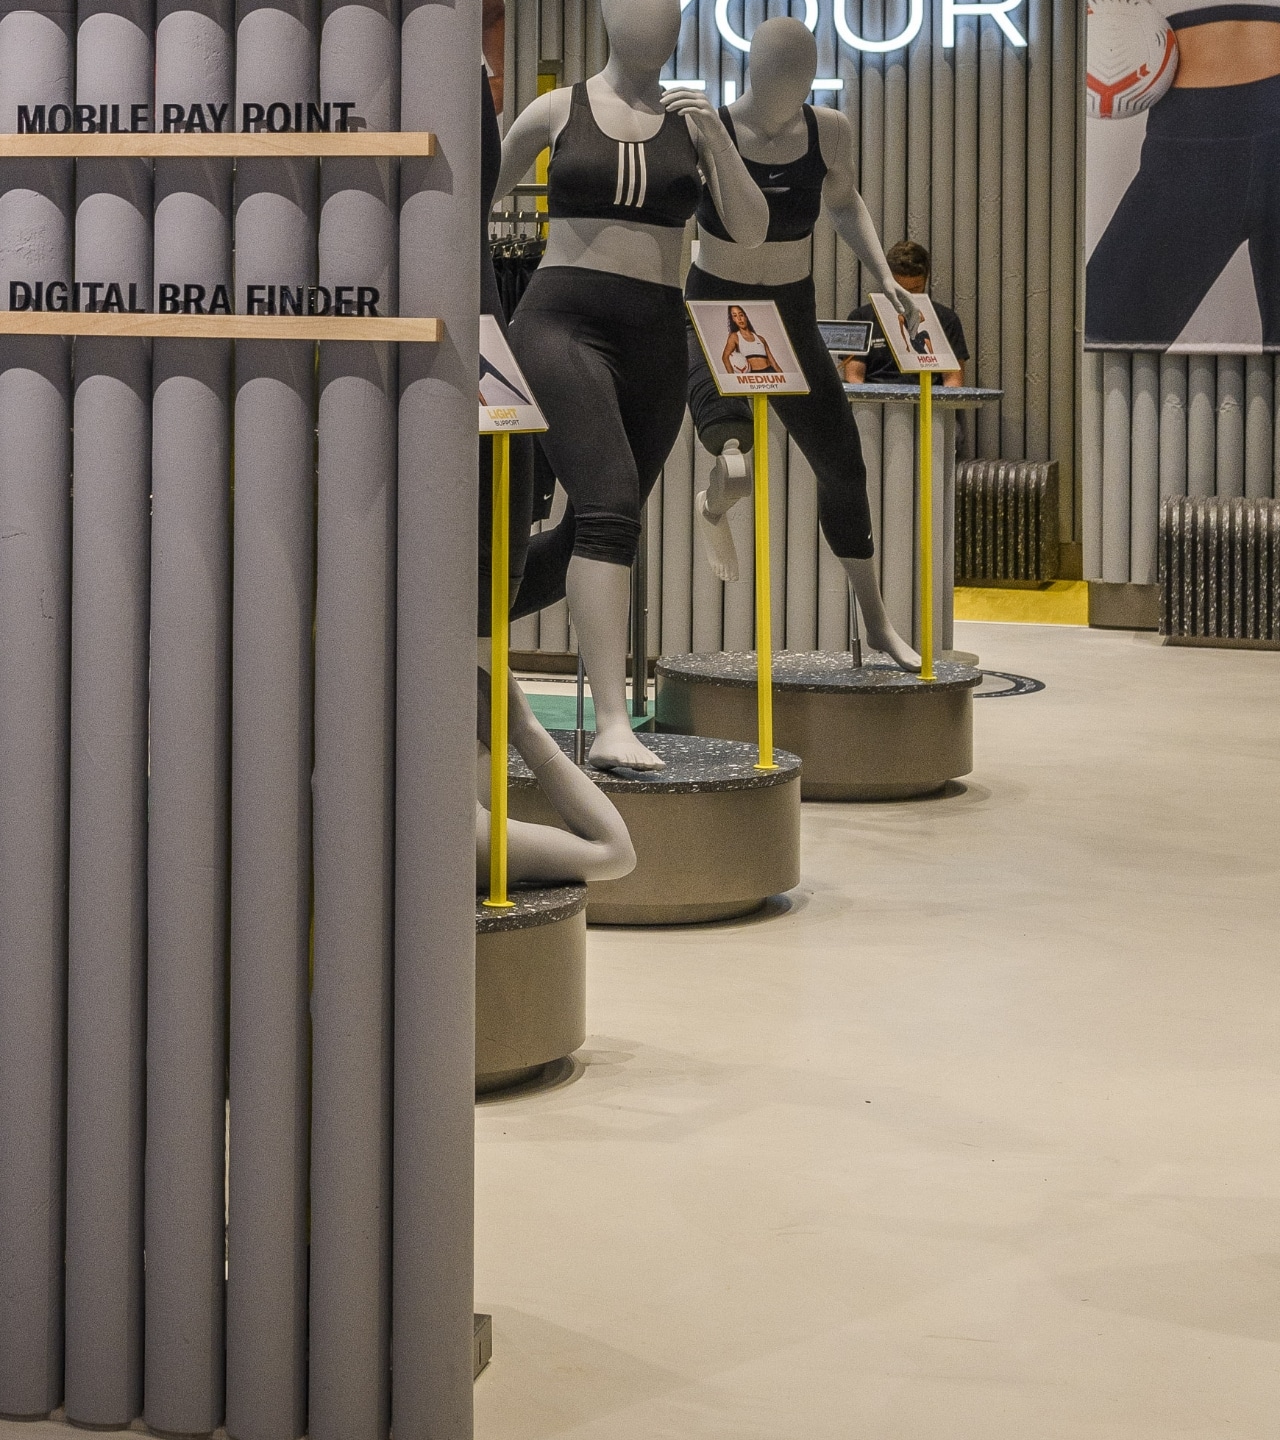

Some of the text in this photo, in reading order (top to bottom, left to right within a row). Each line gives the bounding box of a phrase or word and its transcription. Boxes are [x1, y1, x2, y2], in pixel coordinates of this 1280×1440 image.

[16, 102, 357, 134] MOBILE PAY POINT
[8, 280, 381, 318] DIGITAL BRA FINDER
[917, 355, 938, 363] HIGH
[737, 374, 787, 385] MEDIUM
[487, 407, 518, 420] LIGHT
[494, 419, 520, 427] SUPPORT
